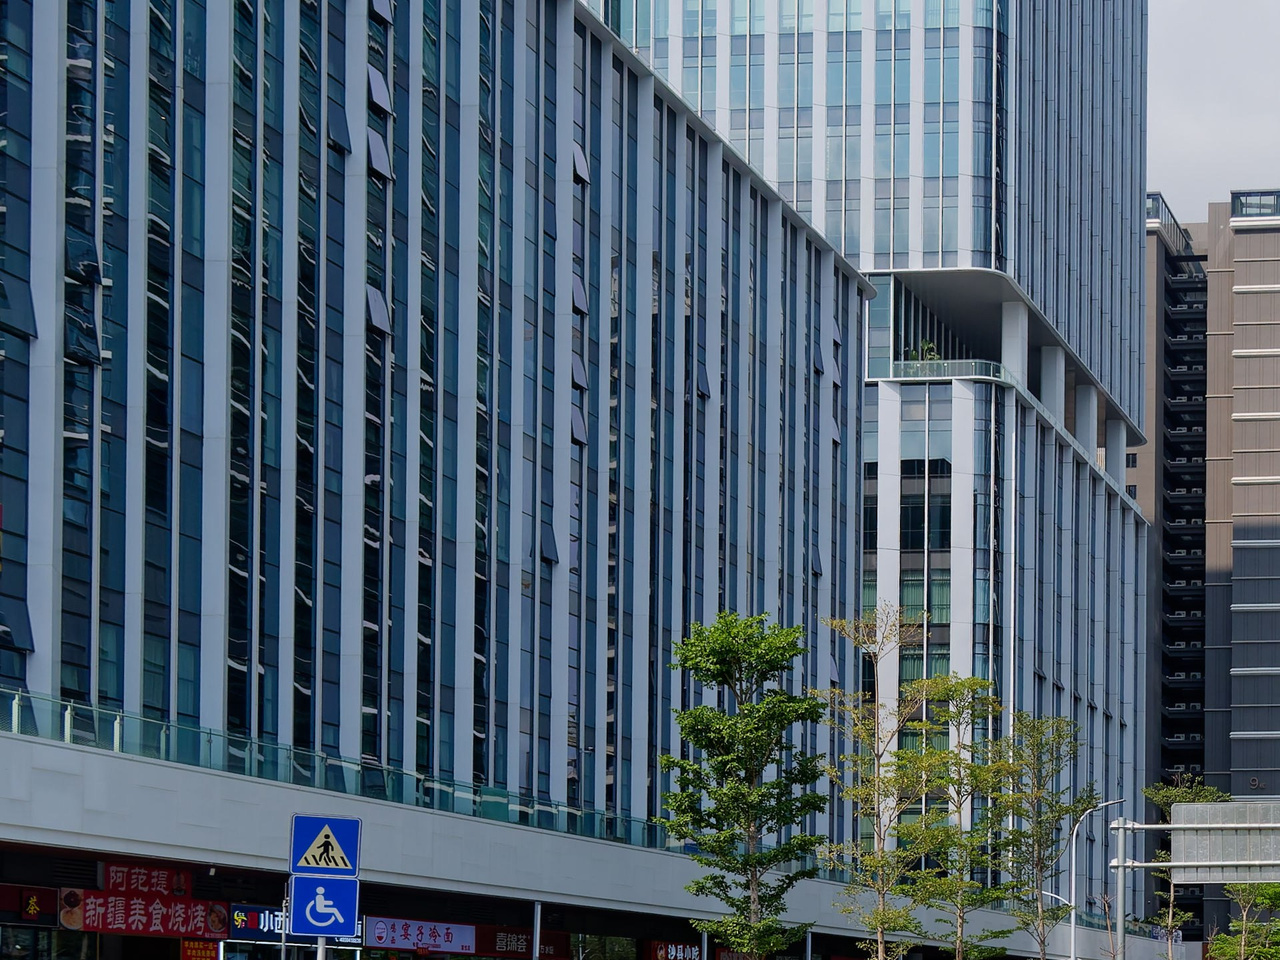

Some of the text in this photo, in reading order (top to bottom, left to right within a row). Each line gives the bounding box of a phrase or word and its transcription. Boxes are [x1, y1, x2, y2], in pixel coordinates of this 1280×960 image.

[26, 896, 40, 916] 茶
[85, 896, 207, 936] 新疆美食烧烤
[668, 944, 699, 960] 沙县小吃
